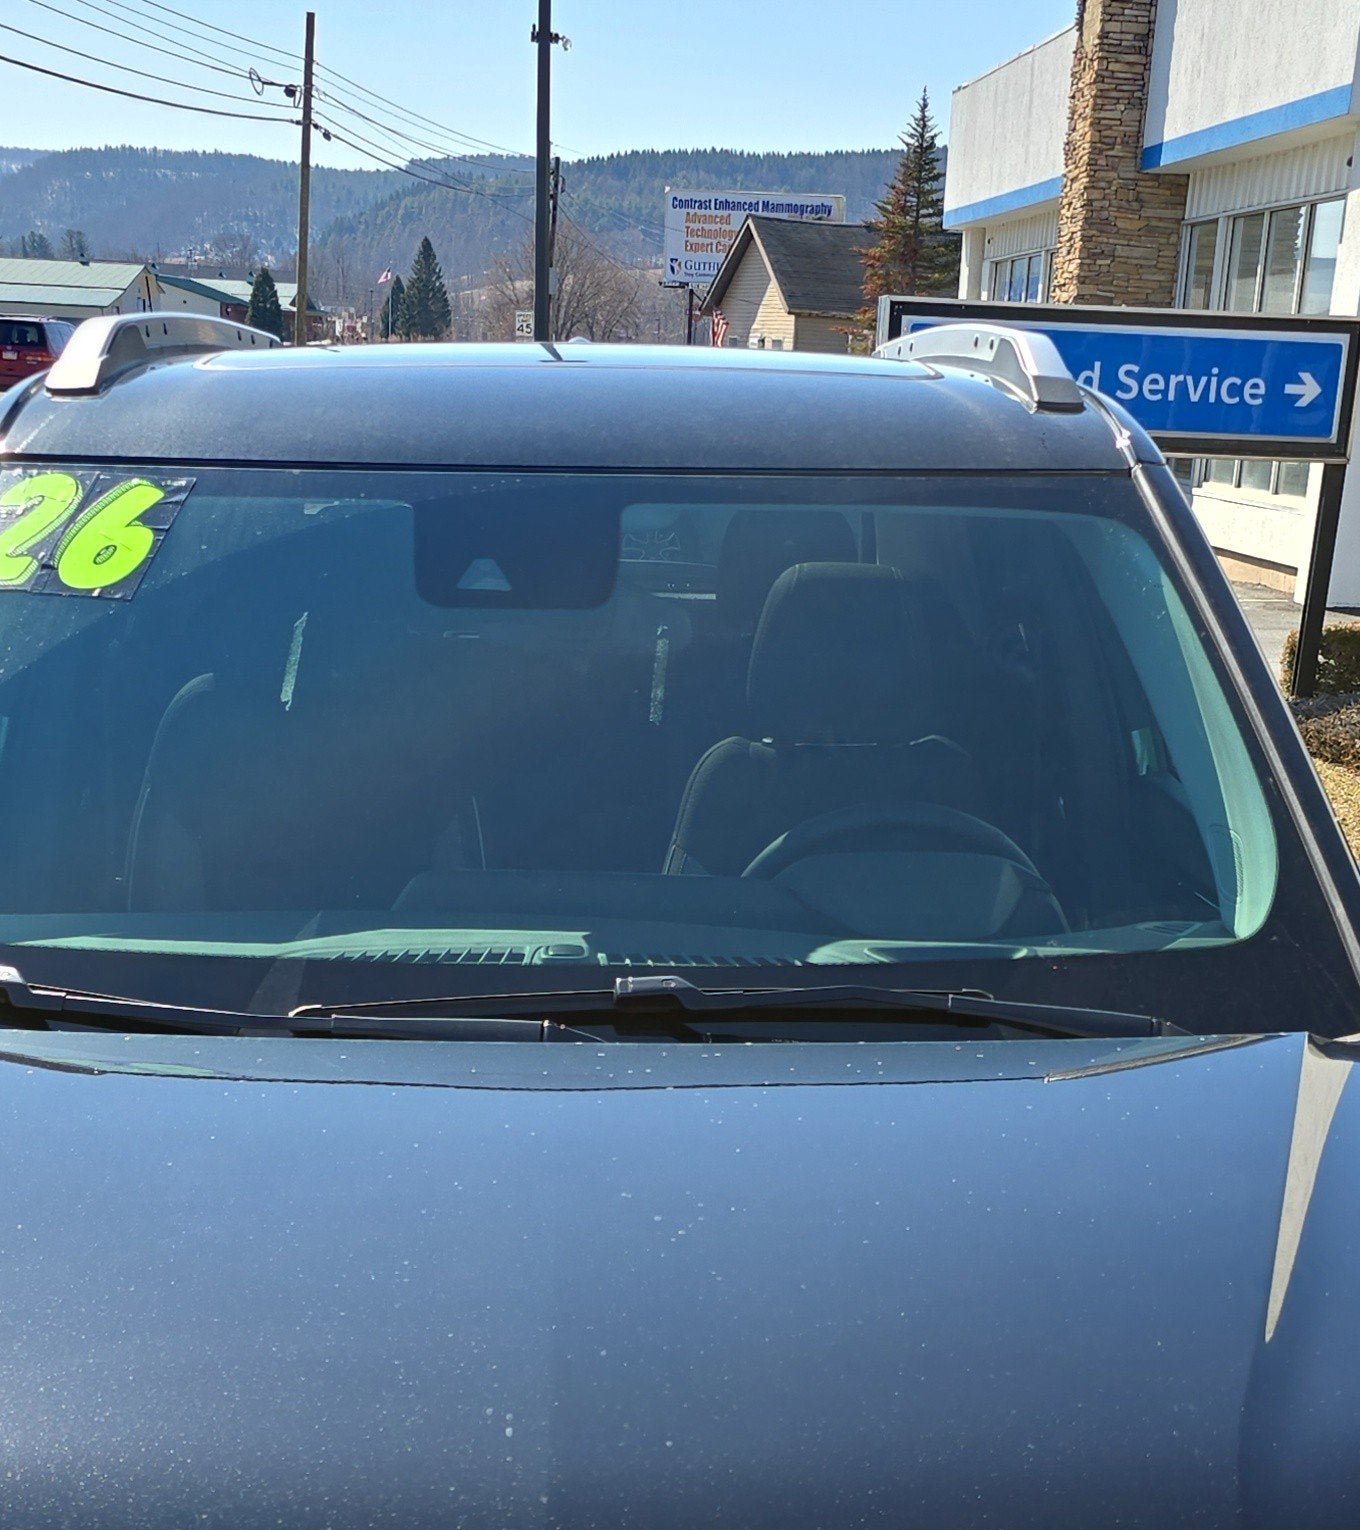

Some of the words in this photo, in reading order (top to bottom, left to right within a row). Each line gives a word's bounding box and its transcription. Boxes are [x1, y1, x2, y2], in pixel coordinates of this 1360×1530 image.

[671, 196, 712, 210] Contrast
[714, 198, 759, 212] Enhanced
[761, 200, 833, 217] Mammography
[685, 211, 731, 225] Advanced
[685, 241, 713, 253] Expert
[516, 323, 533, 335] 45
[1115, 363, 1267, 405] Service
